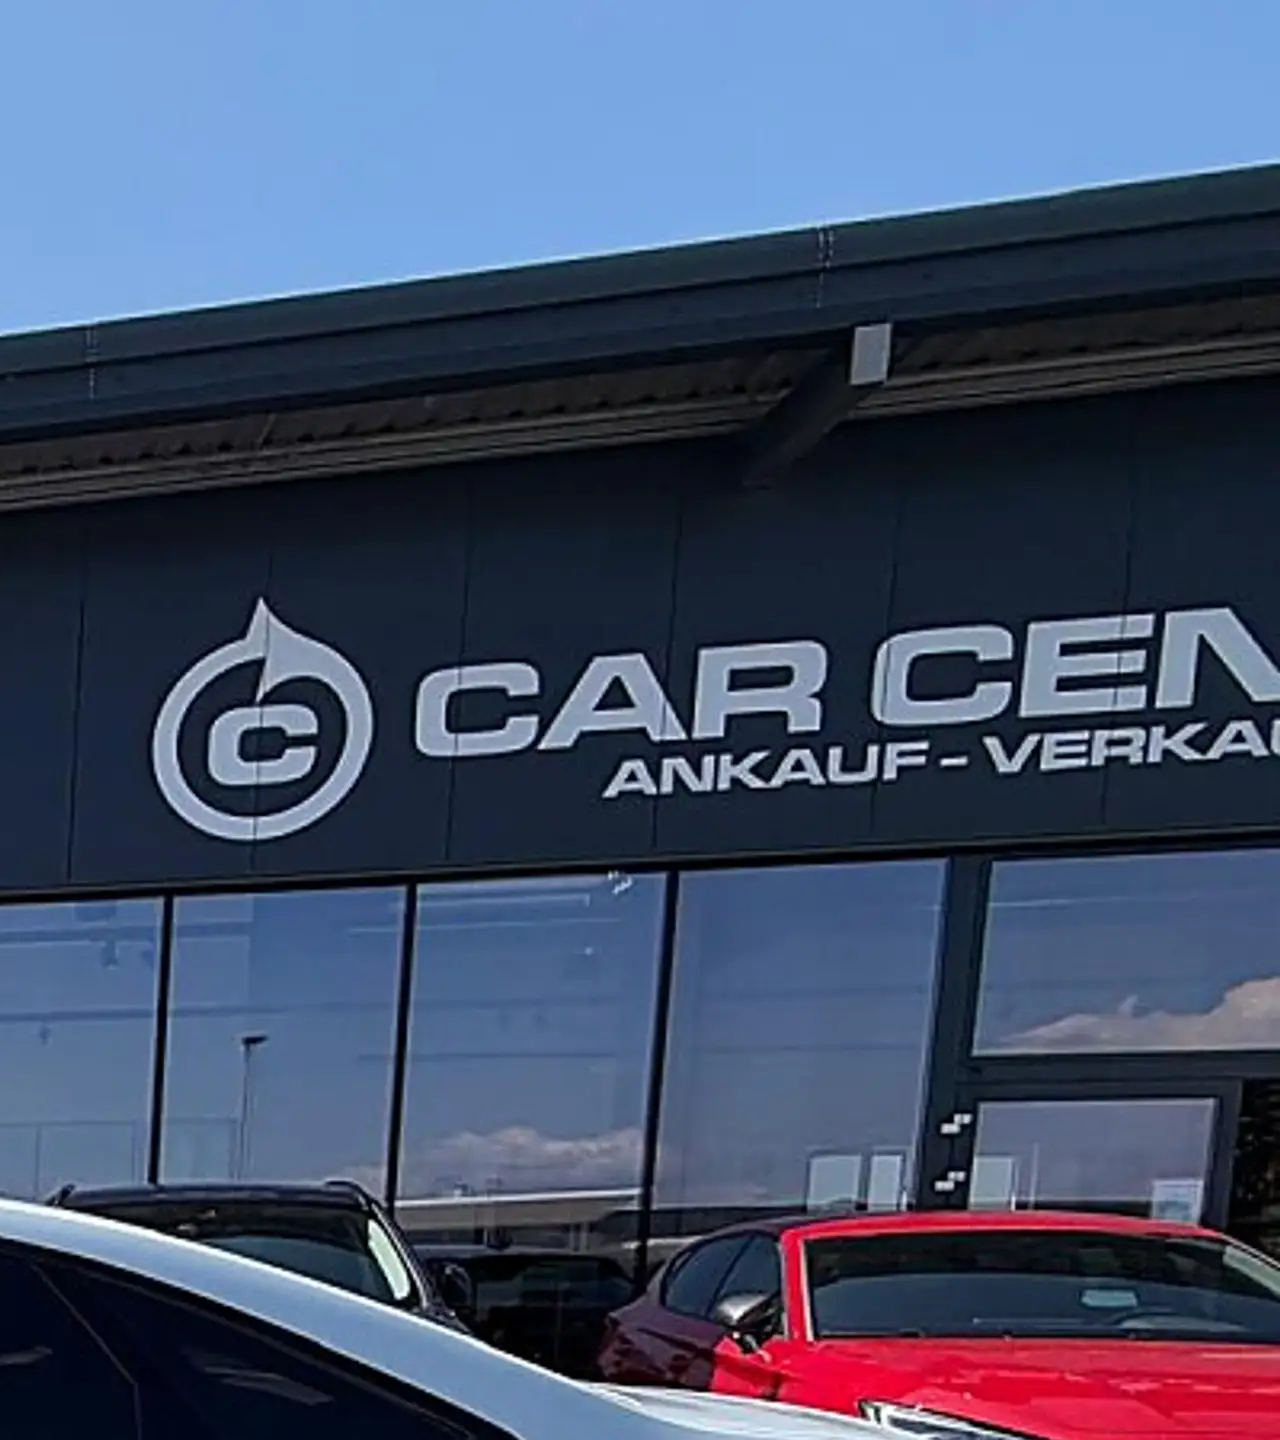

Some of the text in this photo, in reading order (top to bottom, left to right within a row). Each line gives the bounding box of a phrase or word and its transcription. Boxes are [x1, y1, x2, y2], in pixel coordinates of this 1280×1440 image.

[414, 640, 828, 758] CAR
[602, 741, 930, 798] ANKAUF
[983, 719, 1280, 774] VERKA
